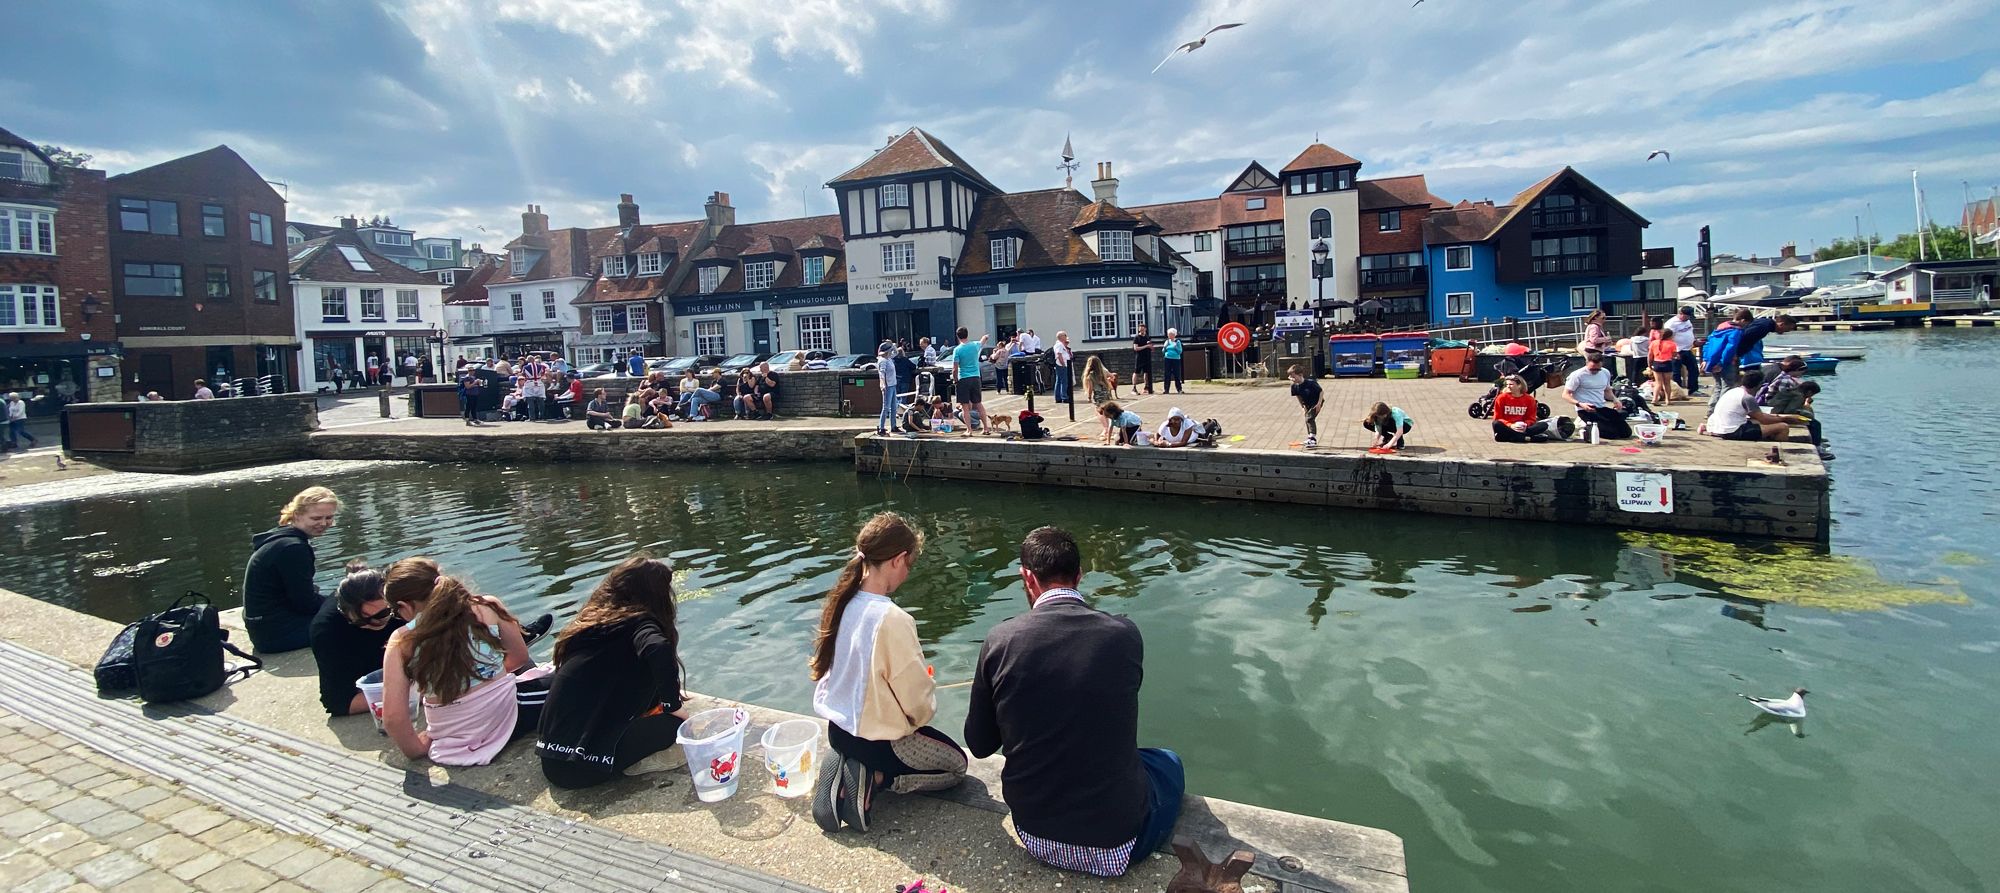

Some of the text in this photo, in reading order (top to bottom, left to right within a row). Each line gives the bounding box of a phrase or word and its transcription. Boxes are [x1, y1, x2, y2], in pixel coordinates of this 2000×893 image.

[915, 279, 939, 287] DININ
[1085, 276, 1148, 285] THE SHIP INN
[786, 297, 825, 305] LYMINGTON
[687, 302, 741, 313] THE SHIP INN
[546, 742, 575, 754] Klein
